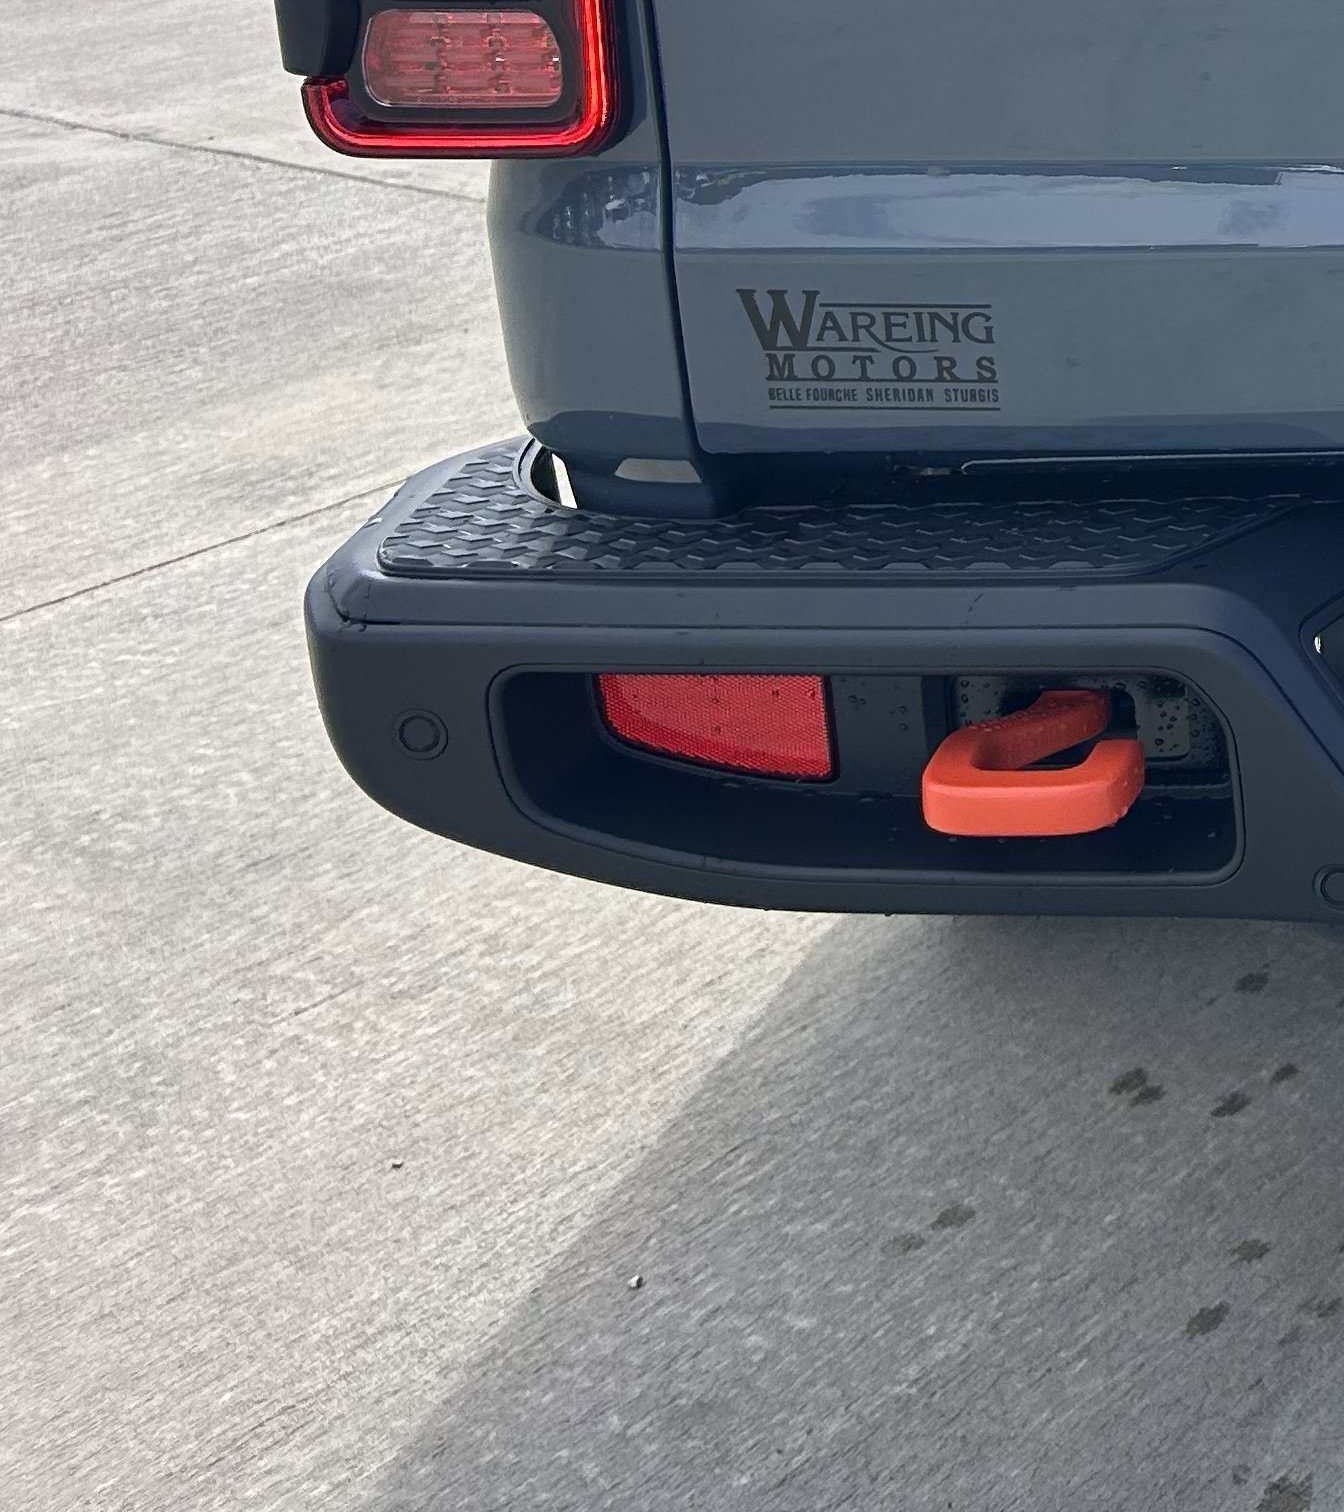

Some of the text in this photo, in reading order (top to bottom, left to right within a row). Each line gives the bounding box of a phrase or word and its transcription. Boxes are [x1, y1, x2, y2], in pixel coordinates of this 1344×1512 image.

[736, 288, 995, 352] WAREING
[766, 353, 998, 381] MOTORS
[768, 388, 999, 402] BELLE FOURCHE SHERIDAN STURGIS
